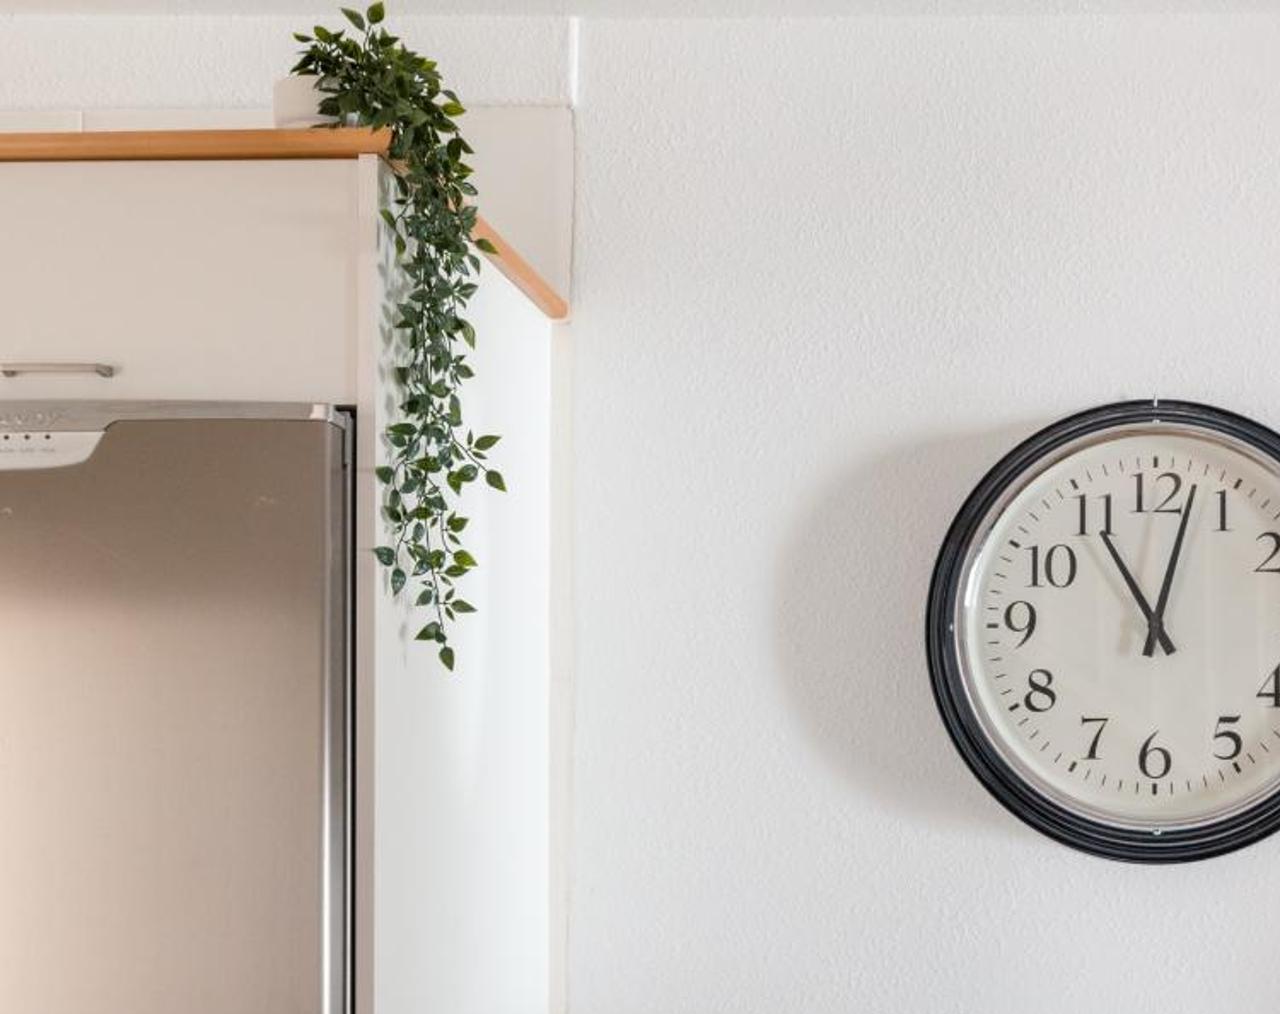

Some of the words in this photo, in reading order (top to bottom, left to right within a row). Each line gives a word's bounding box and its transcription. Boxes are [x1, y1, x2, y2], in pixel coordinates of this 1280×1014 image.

[1073, 493, 1115, 537] 11
[1132, 473, 1182, 514] 12
[1214, 490, 1230, 532] 1
[1024, 544, 1077, 588] 10
[1004, 601, 1037, 648] 9
[1024, 669, 1056, 712] 8
[1081, 717, 1108, 760] 7
[1138, 731, 1171, 779] 6
[1213, 715, 1242, 760] 5
